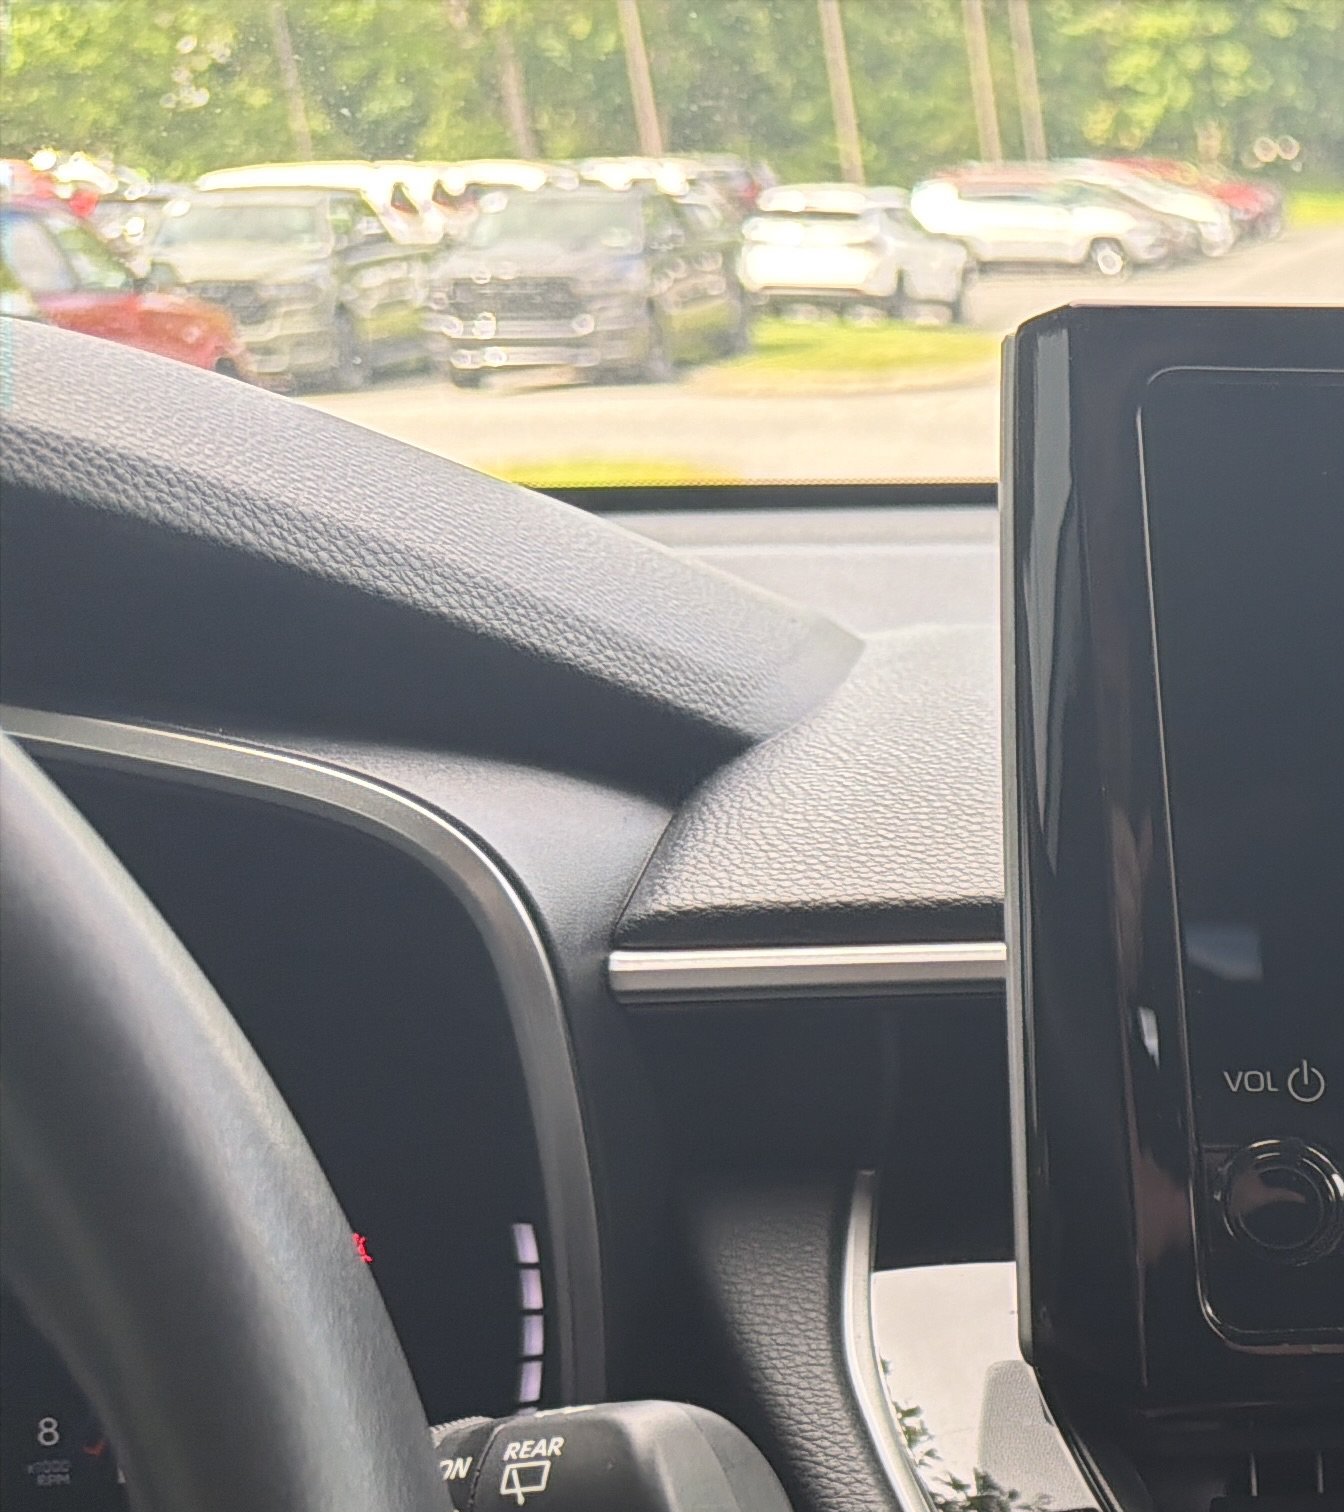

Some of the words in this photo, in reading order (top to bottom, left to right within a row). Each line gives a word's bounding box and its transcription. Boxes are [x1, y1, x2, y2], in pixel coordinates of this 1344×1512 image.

[1223, 1070, 1280, 1093] VOL
[36, 1416, 61, 1447] 8
[502, 1437, 566, 1461] REAR
